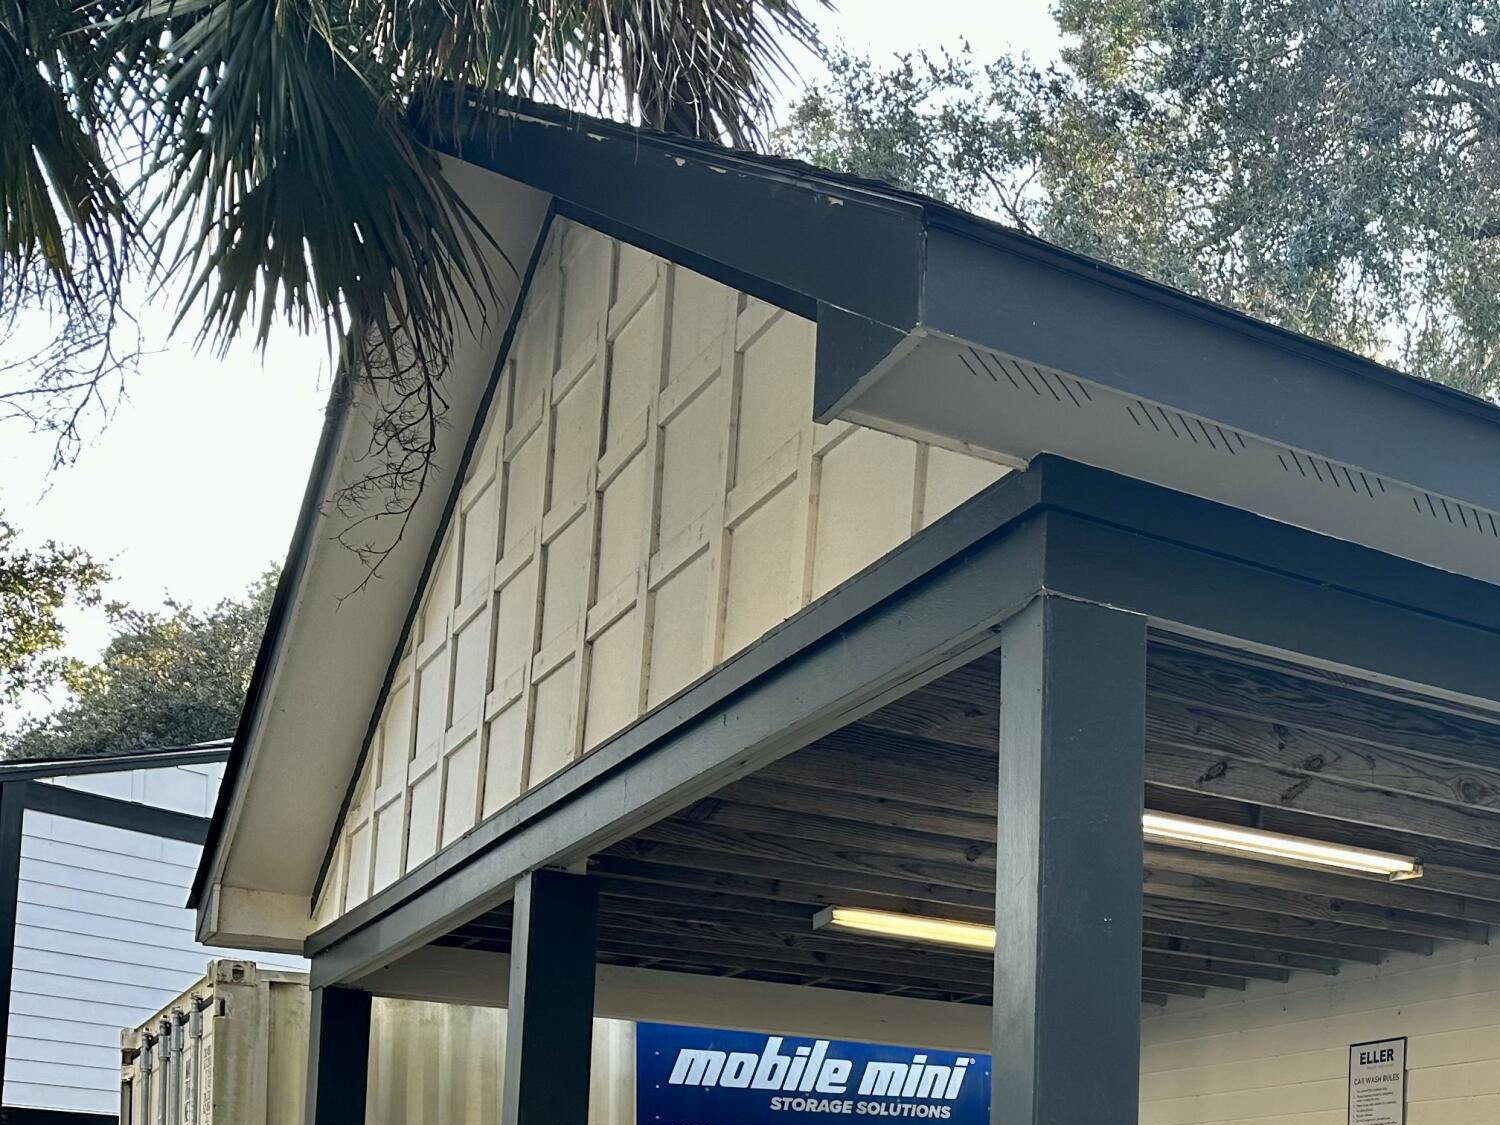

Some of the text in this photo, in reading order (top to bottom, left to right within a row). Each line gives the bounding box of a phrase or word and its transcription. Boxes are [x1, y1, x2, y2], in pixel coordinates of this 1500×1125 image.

[1360, 1048, 1394, 1065] ELLER
[669, 1036, 970, 1100] mobile mini
[1366, 1075, 1382, 1084] WASH
[1383, 1073, 1400, 1082] RULES
[770, 1096, 951, 1119] STORAGE SOLUTIONS
